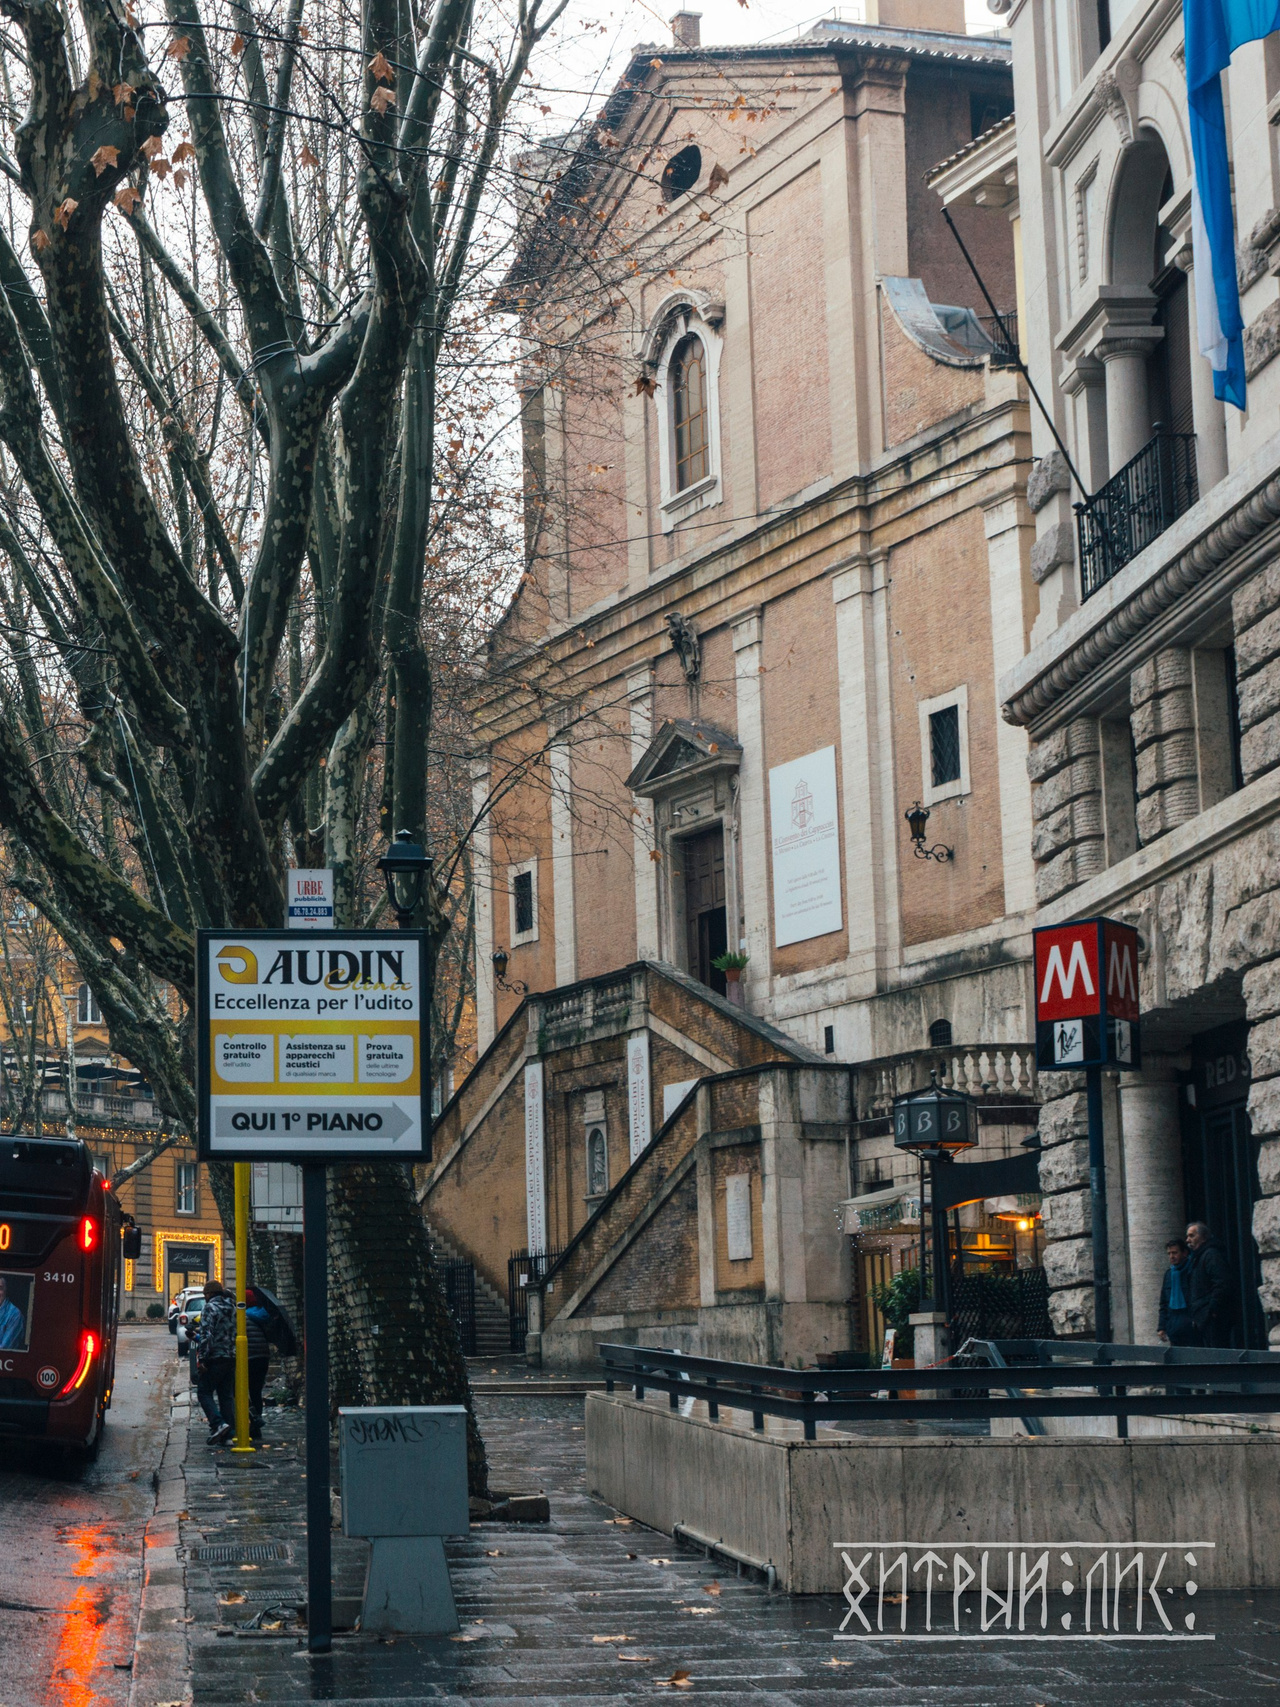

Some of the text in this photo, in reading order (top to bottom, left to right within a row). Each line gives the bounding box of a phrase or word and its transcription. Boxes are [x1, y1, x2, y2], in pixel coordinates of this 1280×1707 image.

[297, 880, 324, 895] URBE
[262, 950, 405, 986] AUDIN
[1040, 941, 1095, 1003] M
[1108, 941, 1136, 1002] M
[323, 968, 414, 991] Clinic
[214, 993, 413, 1014] Eccellenza per l'udito
[223, 1052, 261, 1060] gratuito
[286, 1052, 335, 1060] apparecchi
[366, 1052, 403, 1060] gratuita
[1206, 1055, 1236, 1089] RED
[231, 1112, 275, 1131] QUI
[307, 1112, 383, 1131] PIANO
[631, 1081, 639, 1156] Cappuccini
[897, 1113, 906, 1135] B
[916, 1110, 932, 1133] B
[947, 1110, 961, 1132] B
[43, 1272, 74, 1283] 3410
[41, 1373, 55, 1382] 100
